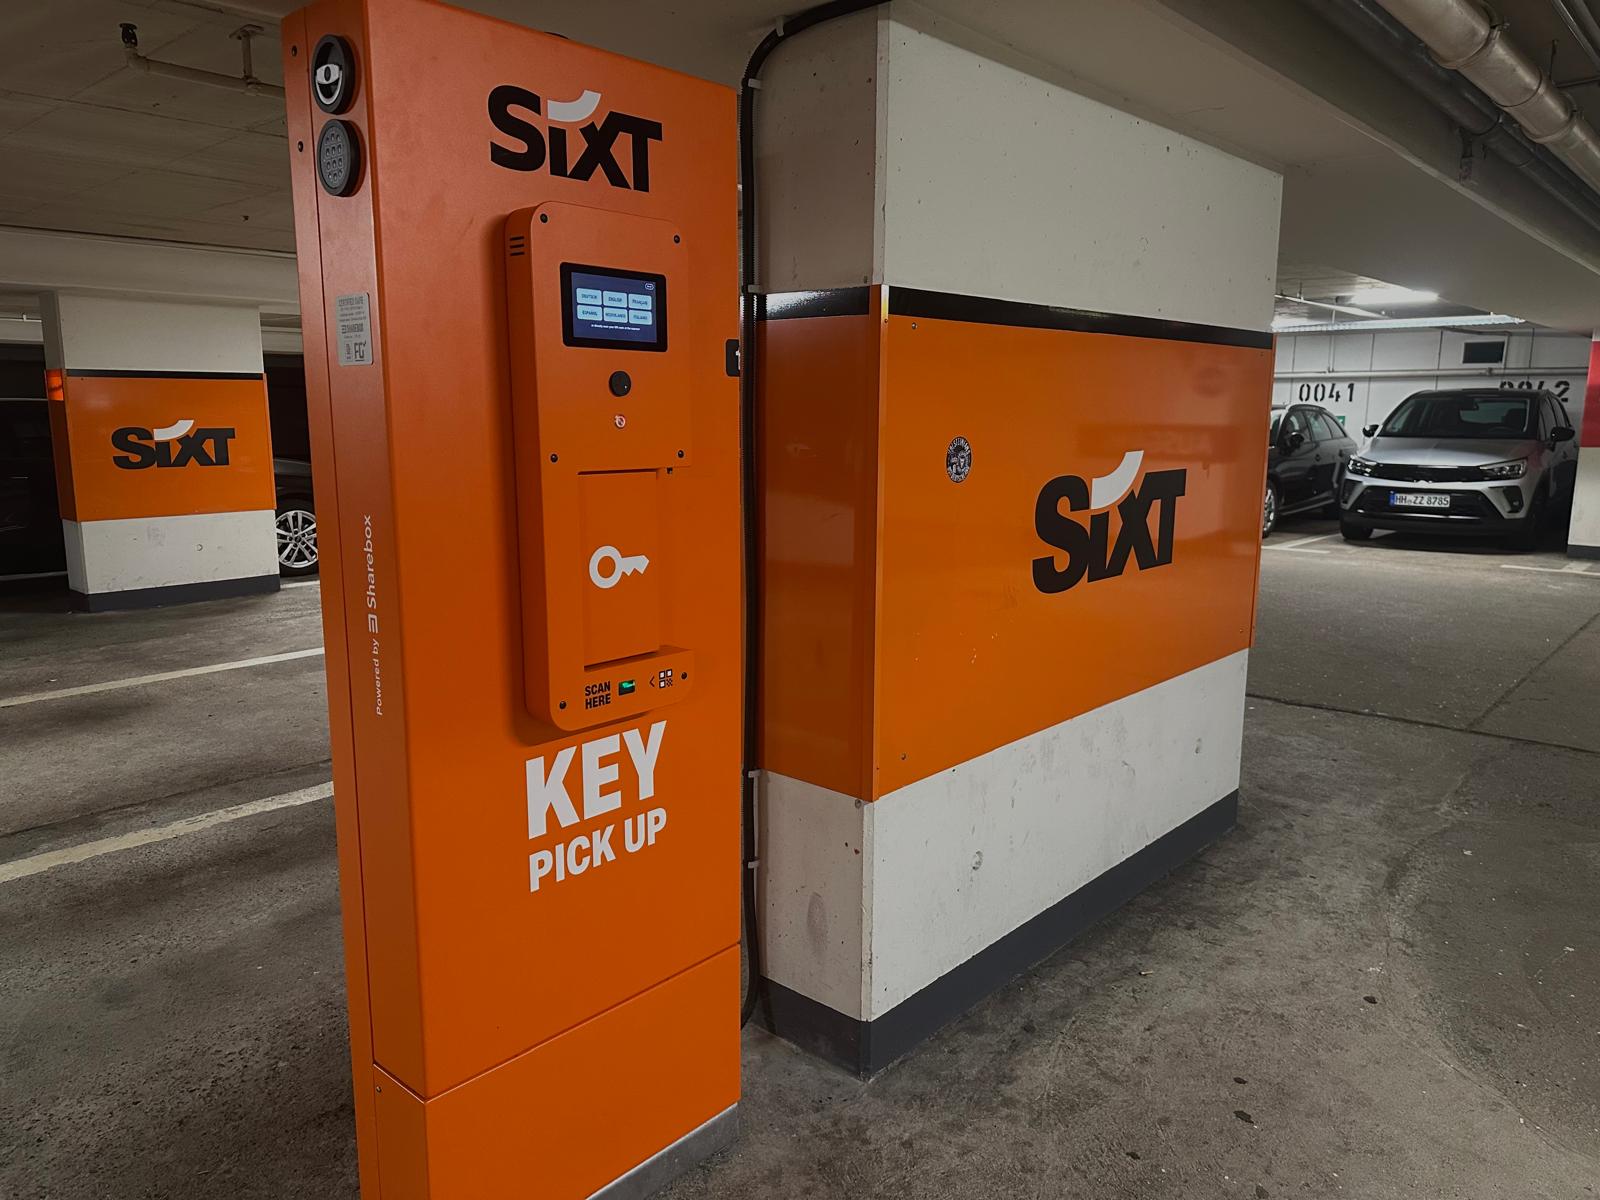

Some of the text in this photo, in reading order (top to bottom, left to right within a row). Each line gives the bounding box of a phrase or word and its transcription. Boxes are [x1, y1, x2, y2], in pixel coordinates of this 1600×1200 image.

[488, 85, 663, 192] SIXT
[1299, 383, 1355, 403] 0041
[111, 419, 236, 470] SIXT
[1032, 450, 1187, 594] SIXT
[363, 514, 383, 716] Powered by Sharebox
[584, 681, 611, 697] SCAN
[585, 693, 611, 710] HERE
[525, 720, 667, 840] KEY
[529, 807, 667, 893] PICK UP
